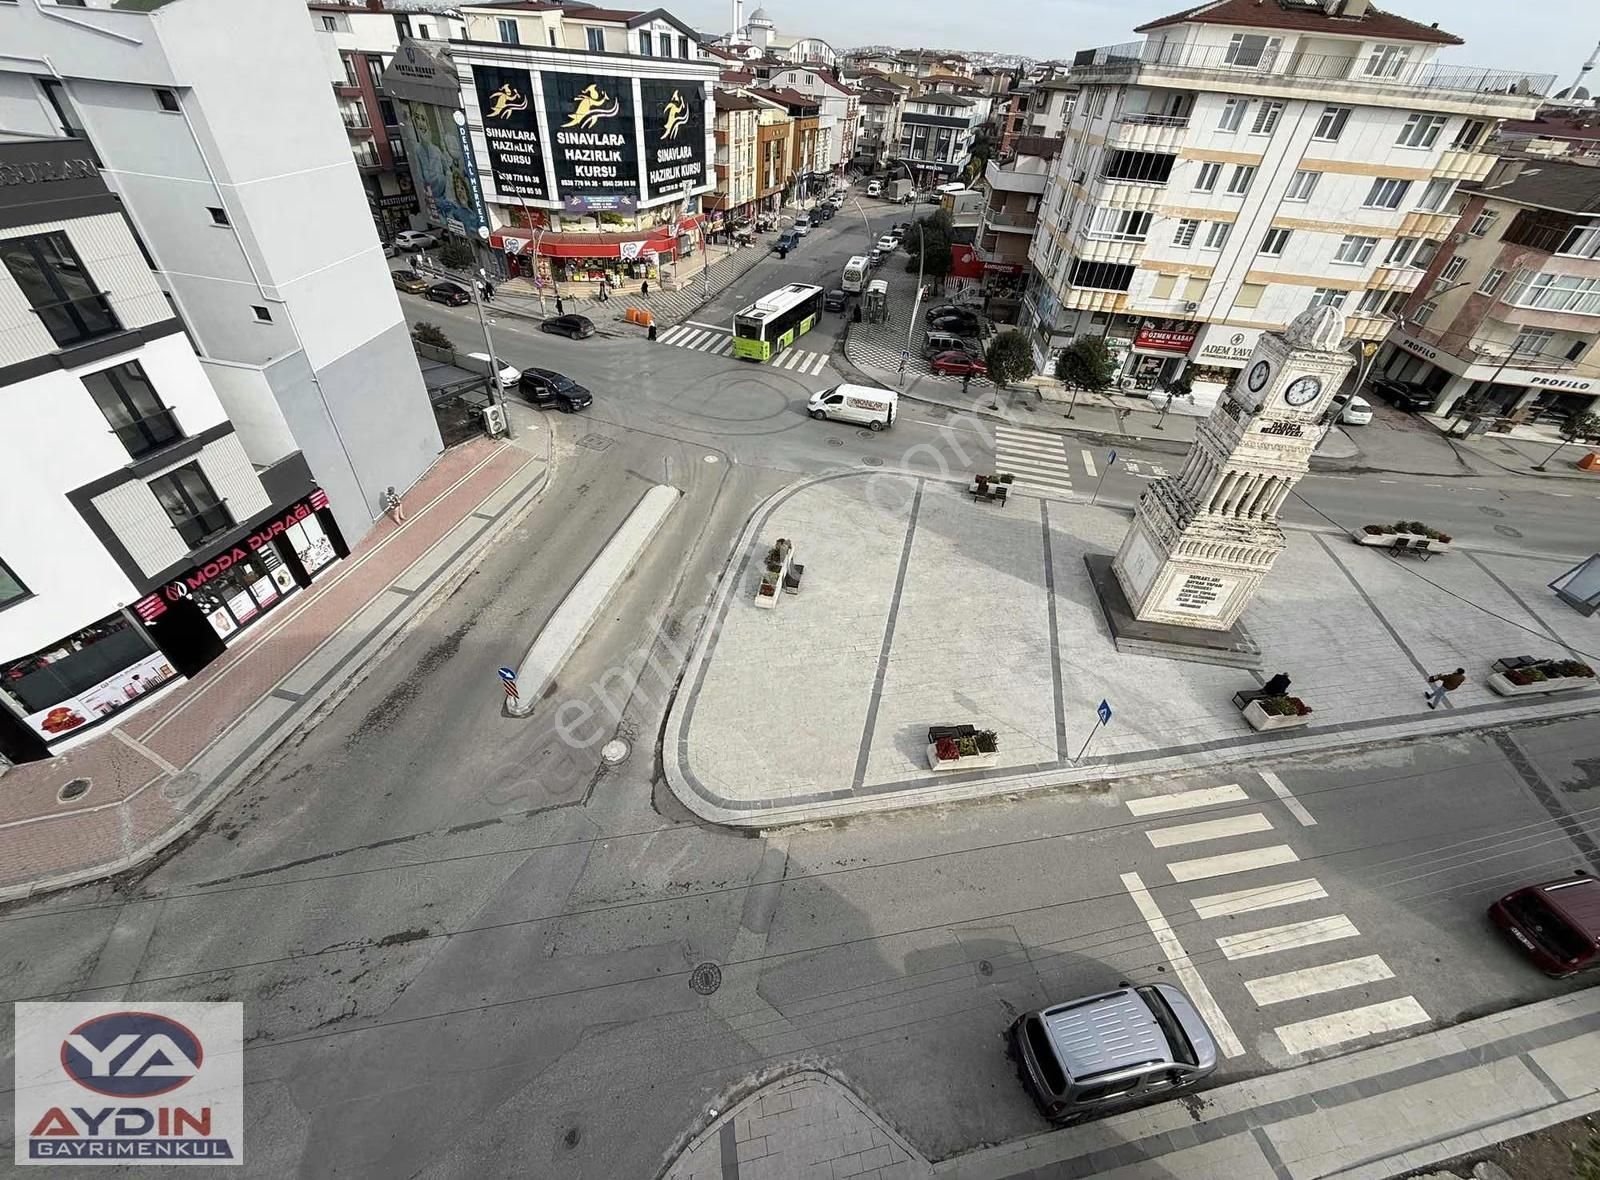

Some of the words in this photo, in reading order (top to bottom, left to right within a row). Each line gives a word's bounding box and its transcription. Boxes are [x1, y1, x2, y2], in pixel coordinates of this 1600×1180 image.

[485, 127, 536, 141] SINAVLARA
[556, 132, 625, 146] SINAVLARA
[492, 140, 535, 153] HAZIRLIK
[500, 154, 531, 165] KURSU
[565, 149, 622, 162] HAZIRLIK
[657, 146, 692, 163] SINAVLARA
[575, 165, 617, 177] KURSU
[650, 165, 680, 184] HAZIRLIK
[681, 162, 701, 177] KURSU
[1172, 334, 1194, 342] KASAP
[1202, 344, 1231, 355] ADEM
[187, 549, 246, 589] MODA
